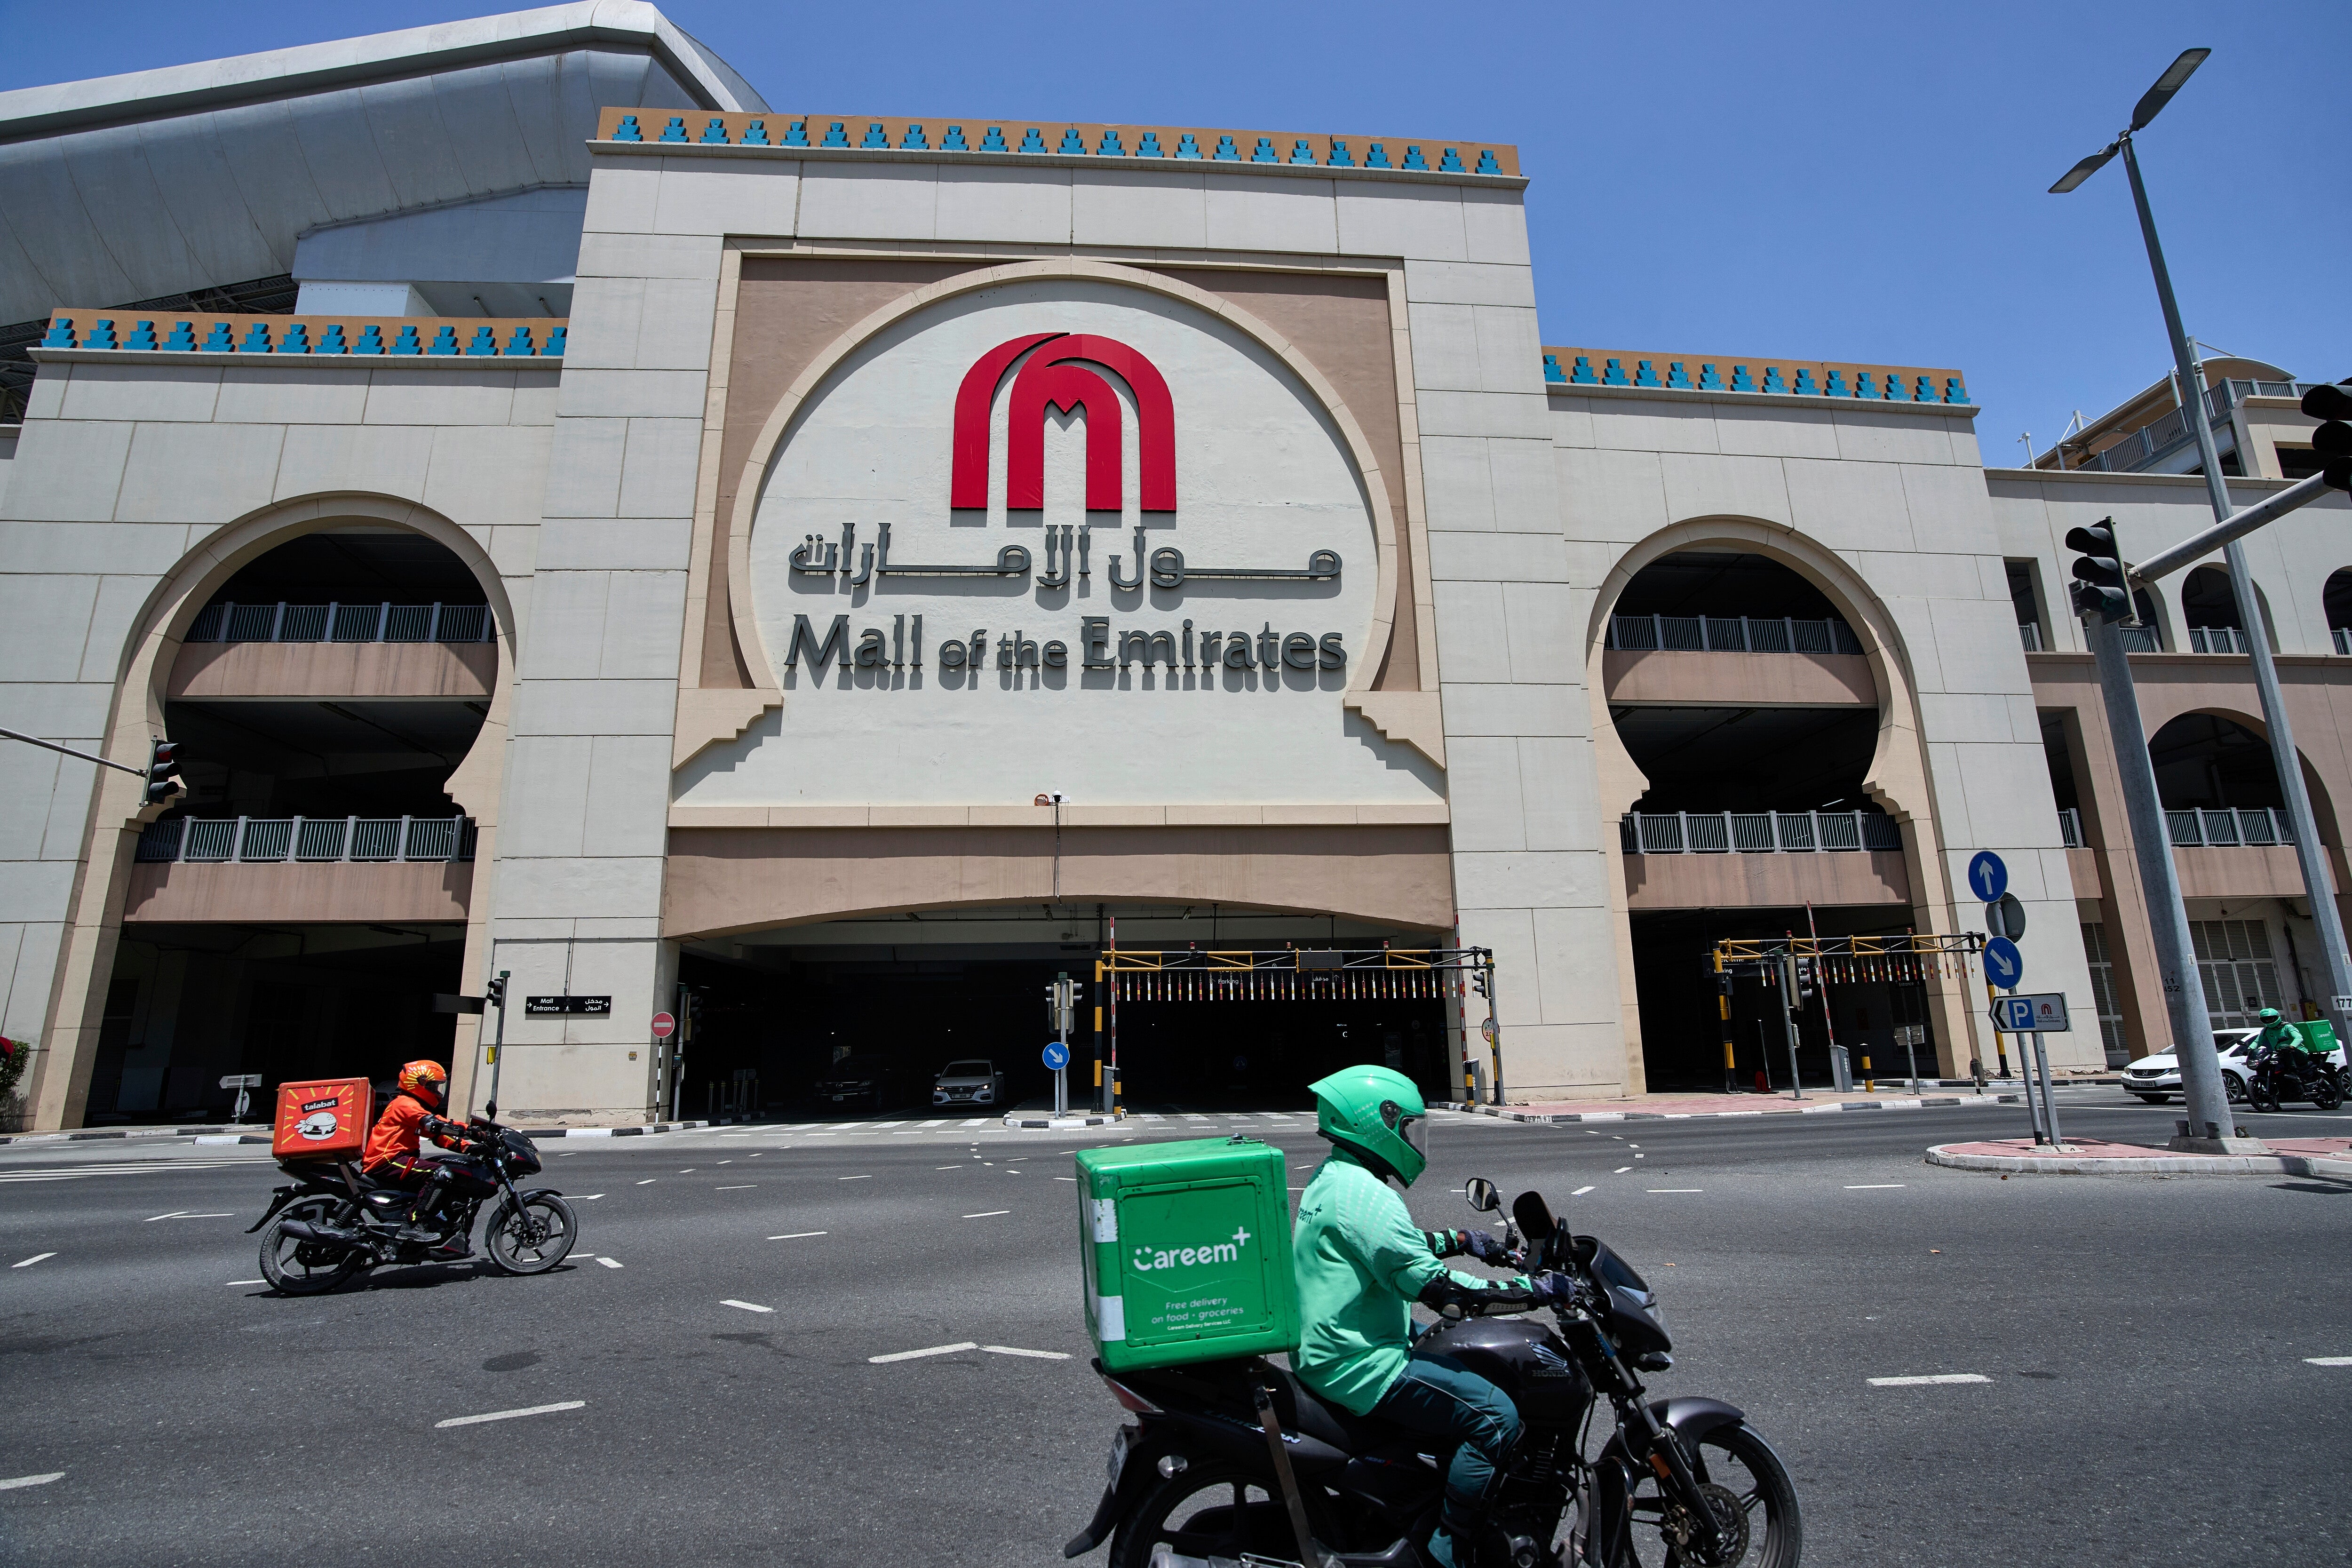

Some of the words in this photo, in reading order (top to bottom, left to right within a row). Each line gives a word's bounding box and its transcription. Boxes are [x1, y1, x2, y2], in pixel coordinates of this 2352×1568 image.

[784, 614, 923, 667] Mall
[939, 629, 987, 667] of
[997, 629, 1068, 668] the
[1081, 616, 1348, 670] Emirates
[2012, 1002, 2028, 1026] P
[304, 1099, 336, 1111] talabat
[1165, 1301, 1187, 1310] Free
[1189, 1297, 1228, 1308] delivery
[1166, 1312, 1189, 1322] food
[1198, 1306, 1244, 1321] groceries
